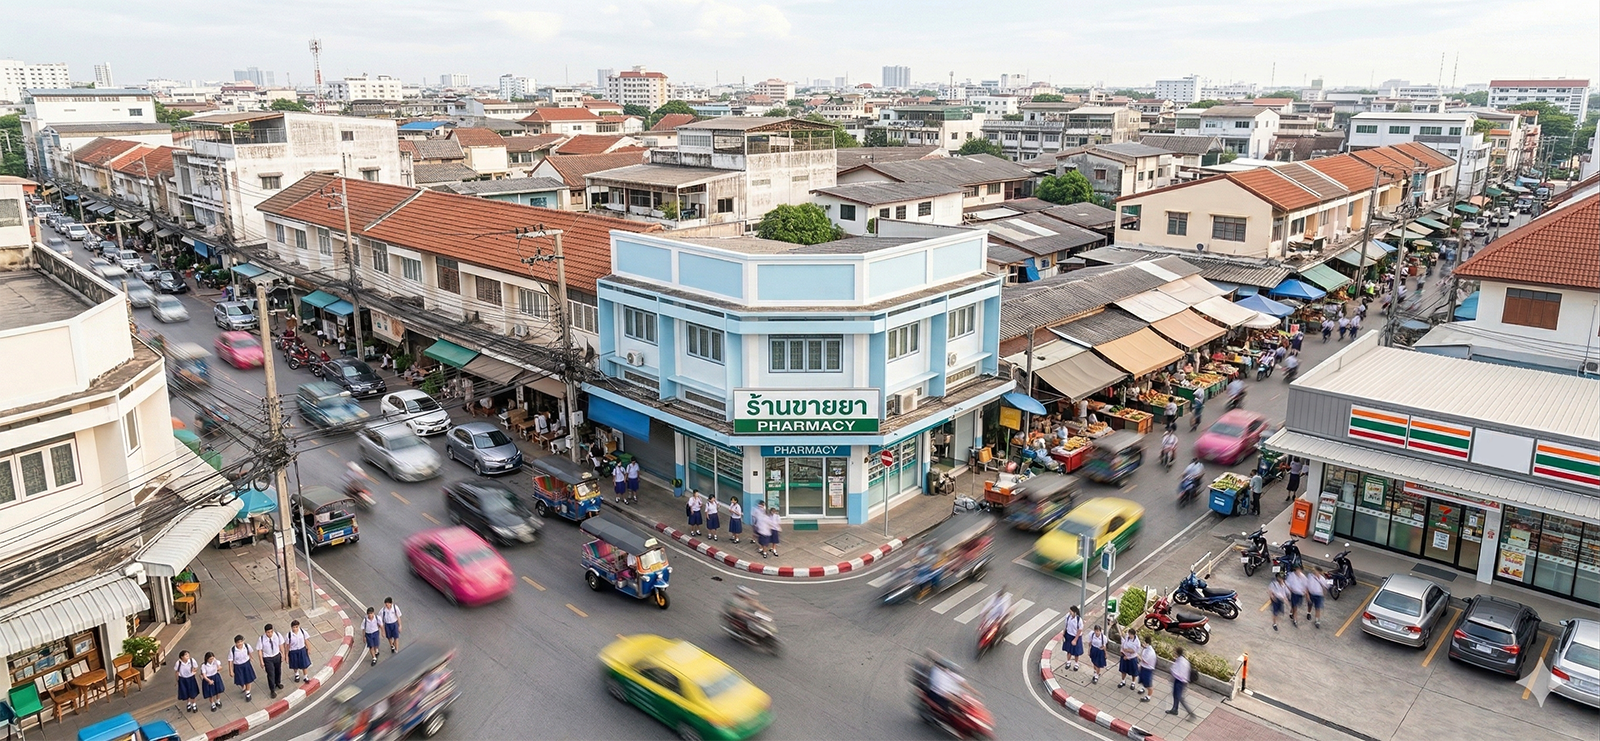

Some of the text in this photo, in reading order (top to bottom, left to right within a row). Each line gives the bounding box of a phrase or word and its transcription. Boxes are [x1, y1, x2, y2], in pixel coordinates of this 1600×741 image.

[746, 393, 867, 416] ร้านขายยา
[757, 420, 856, 432] PHARMACY
[774, 446, 838, 454] PHARMACY
